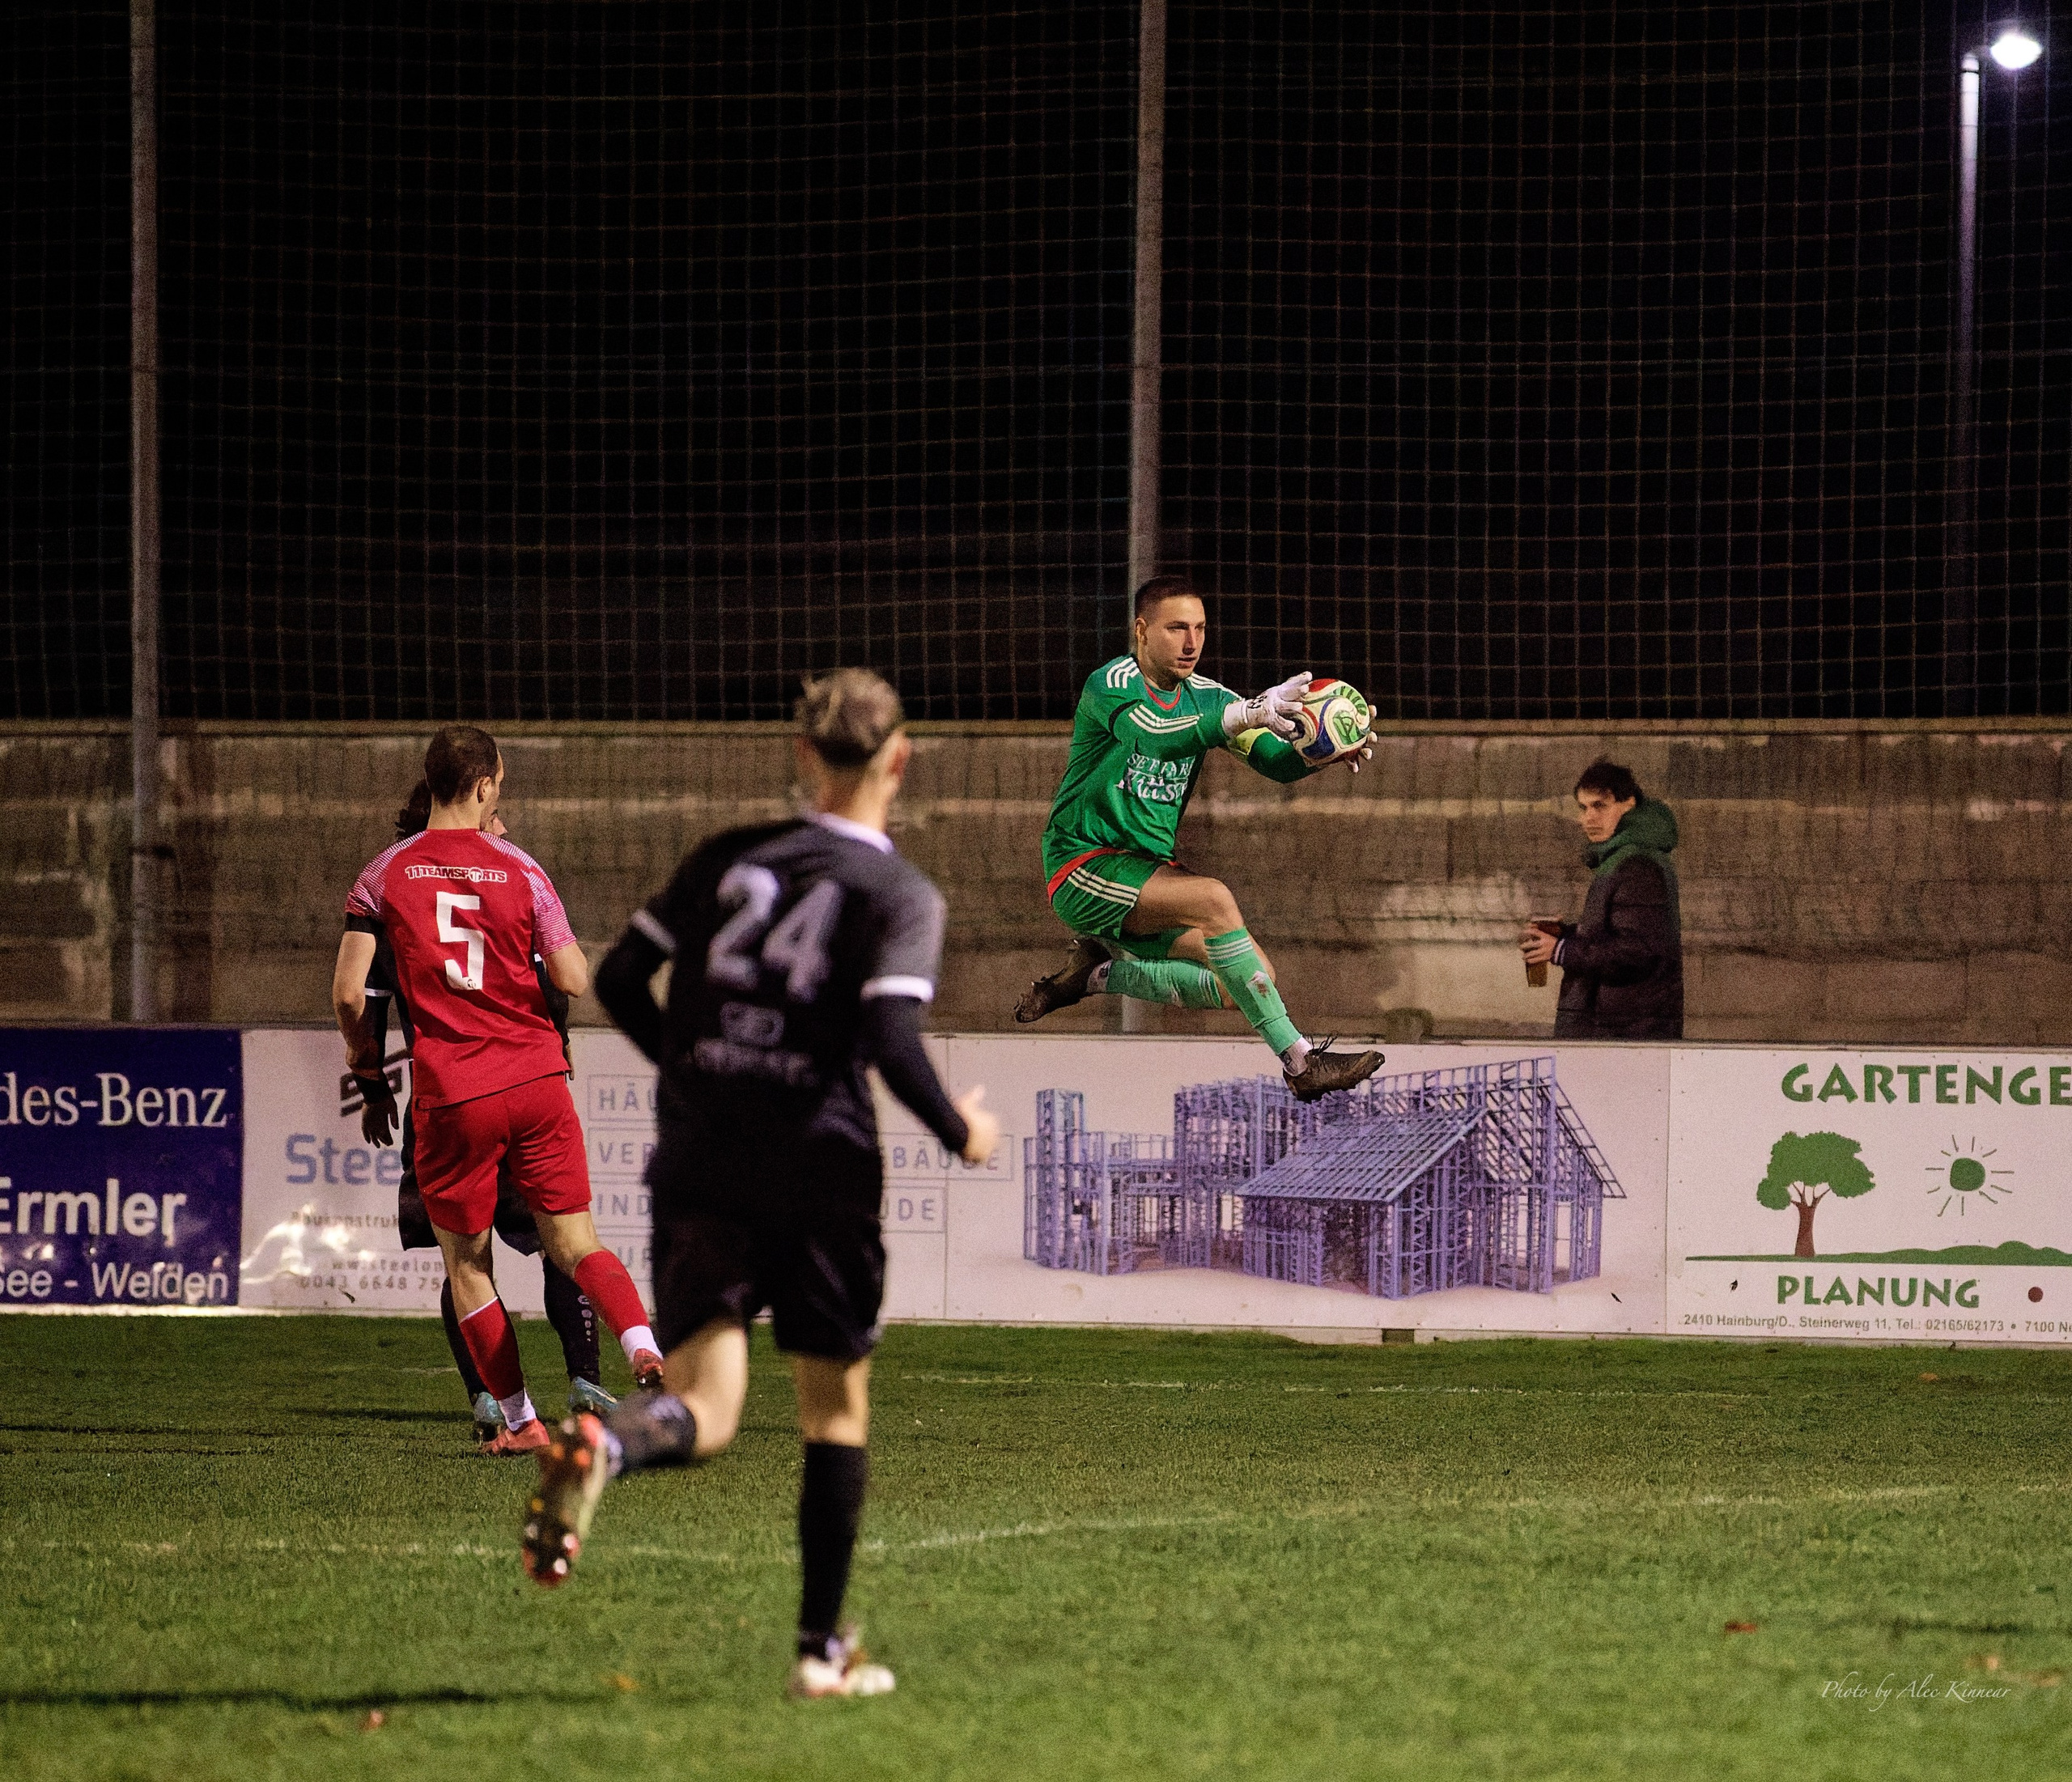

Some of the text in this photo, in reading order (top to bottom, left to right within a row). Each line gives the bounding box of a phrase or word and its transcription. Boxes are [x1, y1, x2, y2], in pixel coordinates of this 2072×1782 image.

[436, 891, 484, 990] 5
[706, 863, 842, 1002] 24
[0, 1071, 227, 1127] des-Benz
[1781, 1063, 2072, 1105] GARTENGE
[0, 1264, 53, 1297] ee
[1777, 1275, 1980, 1309] PLANUNG
[1684, 1314, 1713, 1326] 2410
[1799, 1316, 1870, 1331] Steinerweg
[2025, 1321, 2054, 1332] 7100
